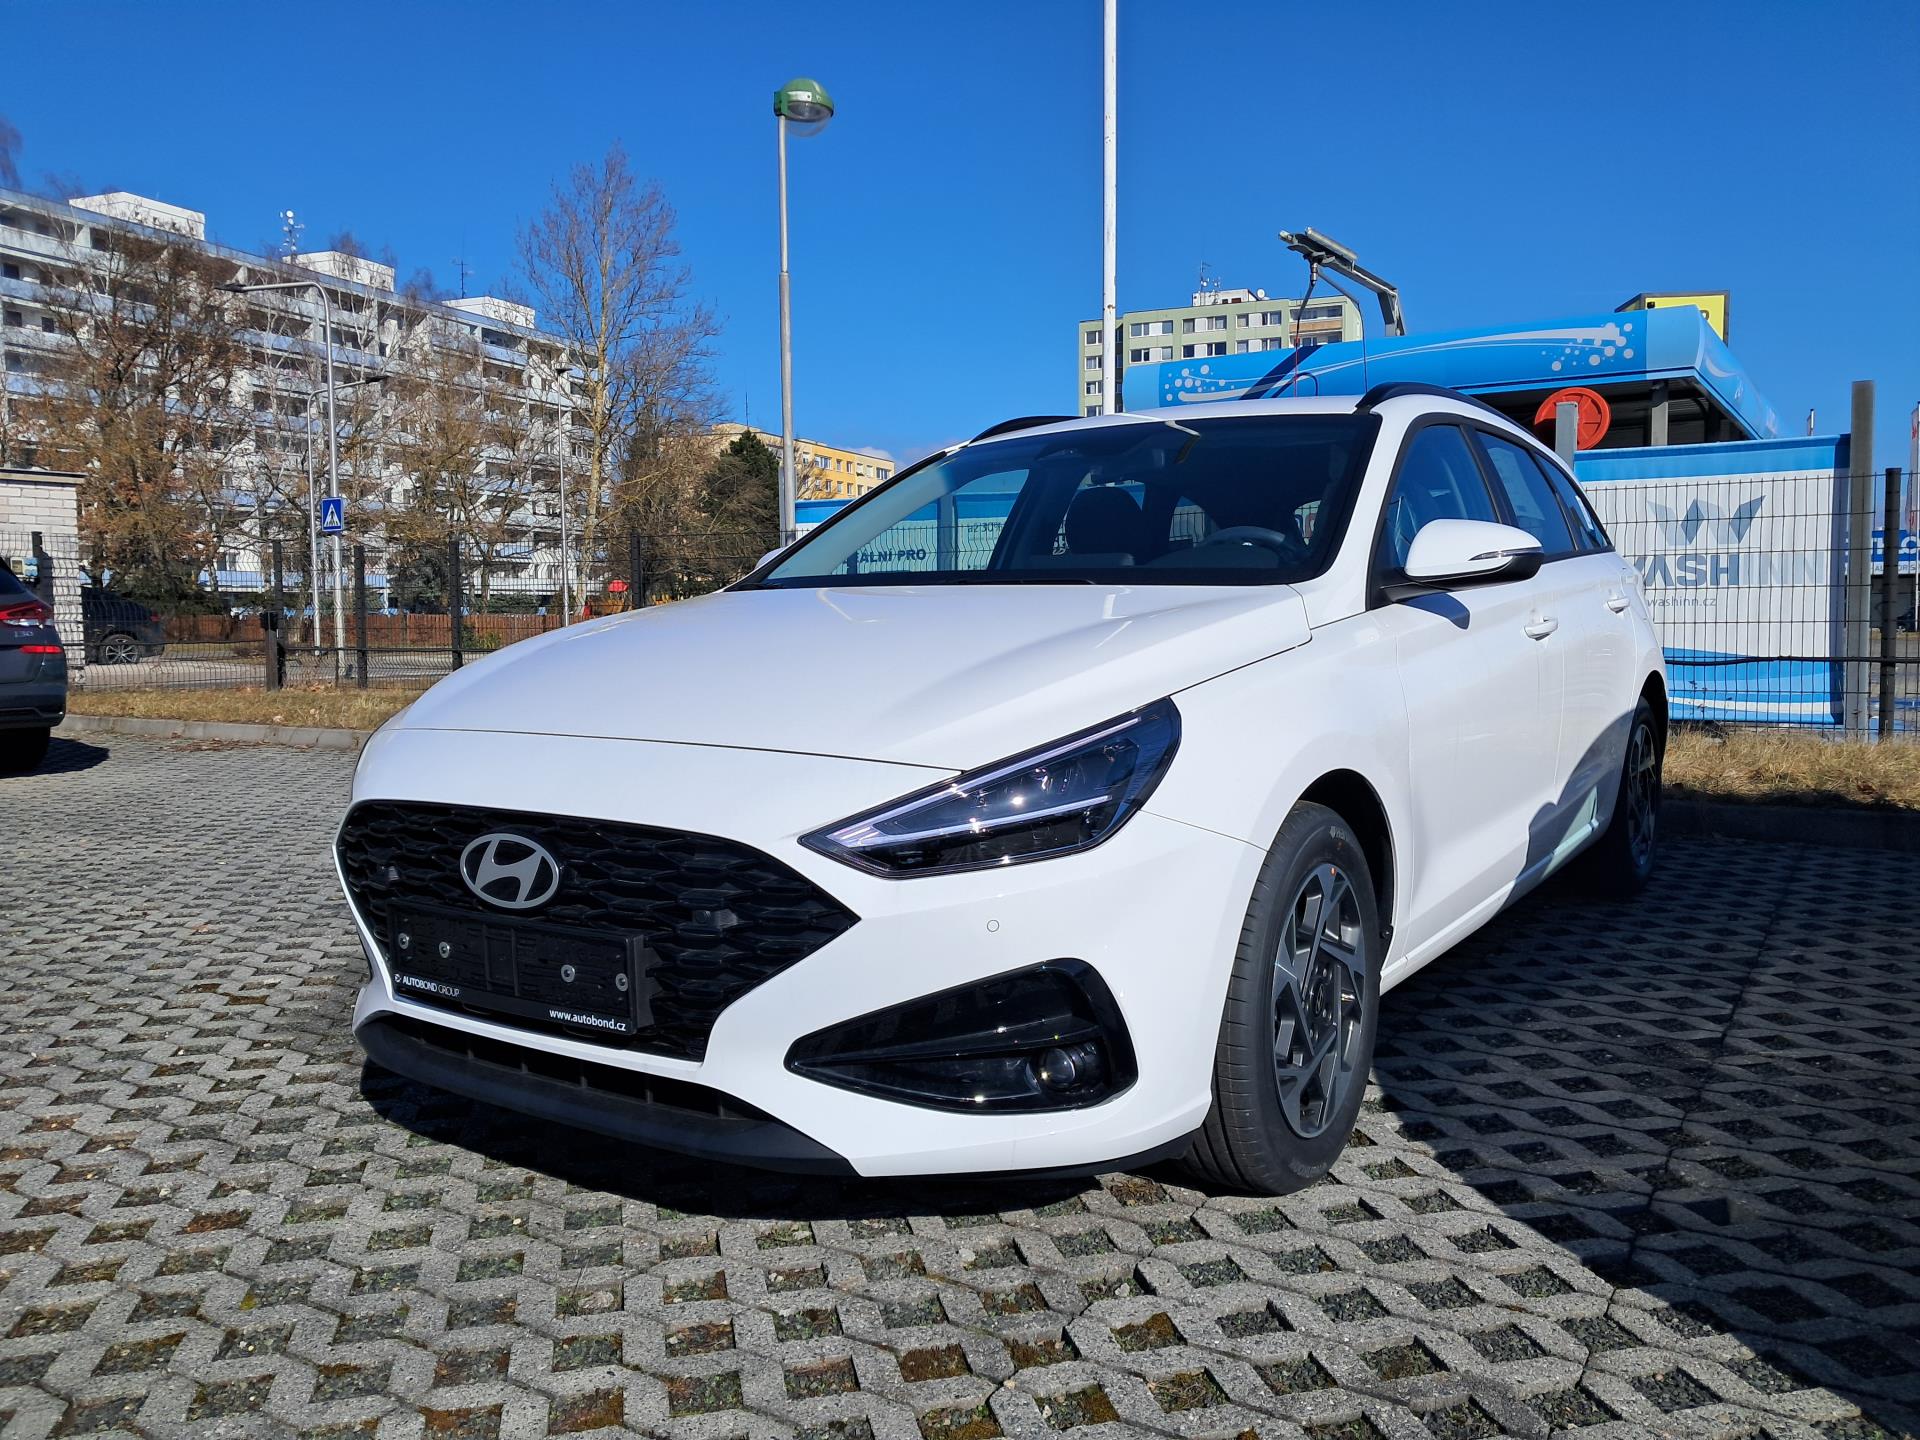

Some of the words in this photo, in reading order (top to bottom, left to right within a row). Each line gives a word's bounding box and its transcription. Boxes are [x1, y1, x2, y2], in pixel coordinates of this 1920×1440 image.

[897, 549, 927, 561] PRO
[402, 975, 438, 992] AUTOBOND
[438, 984, 460, 997] GROUP
[549, 1008, 626, 1031] www.autobond.cz
